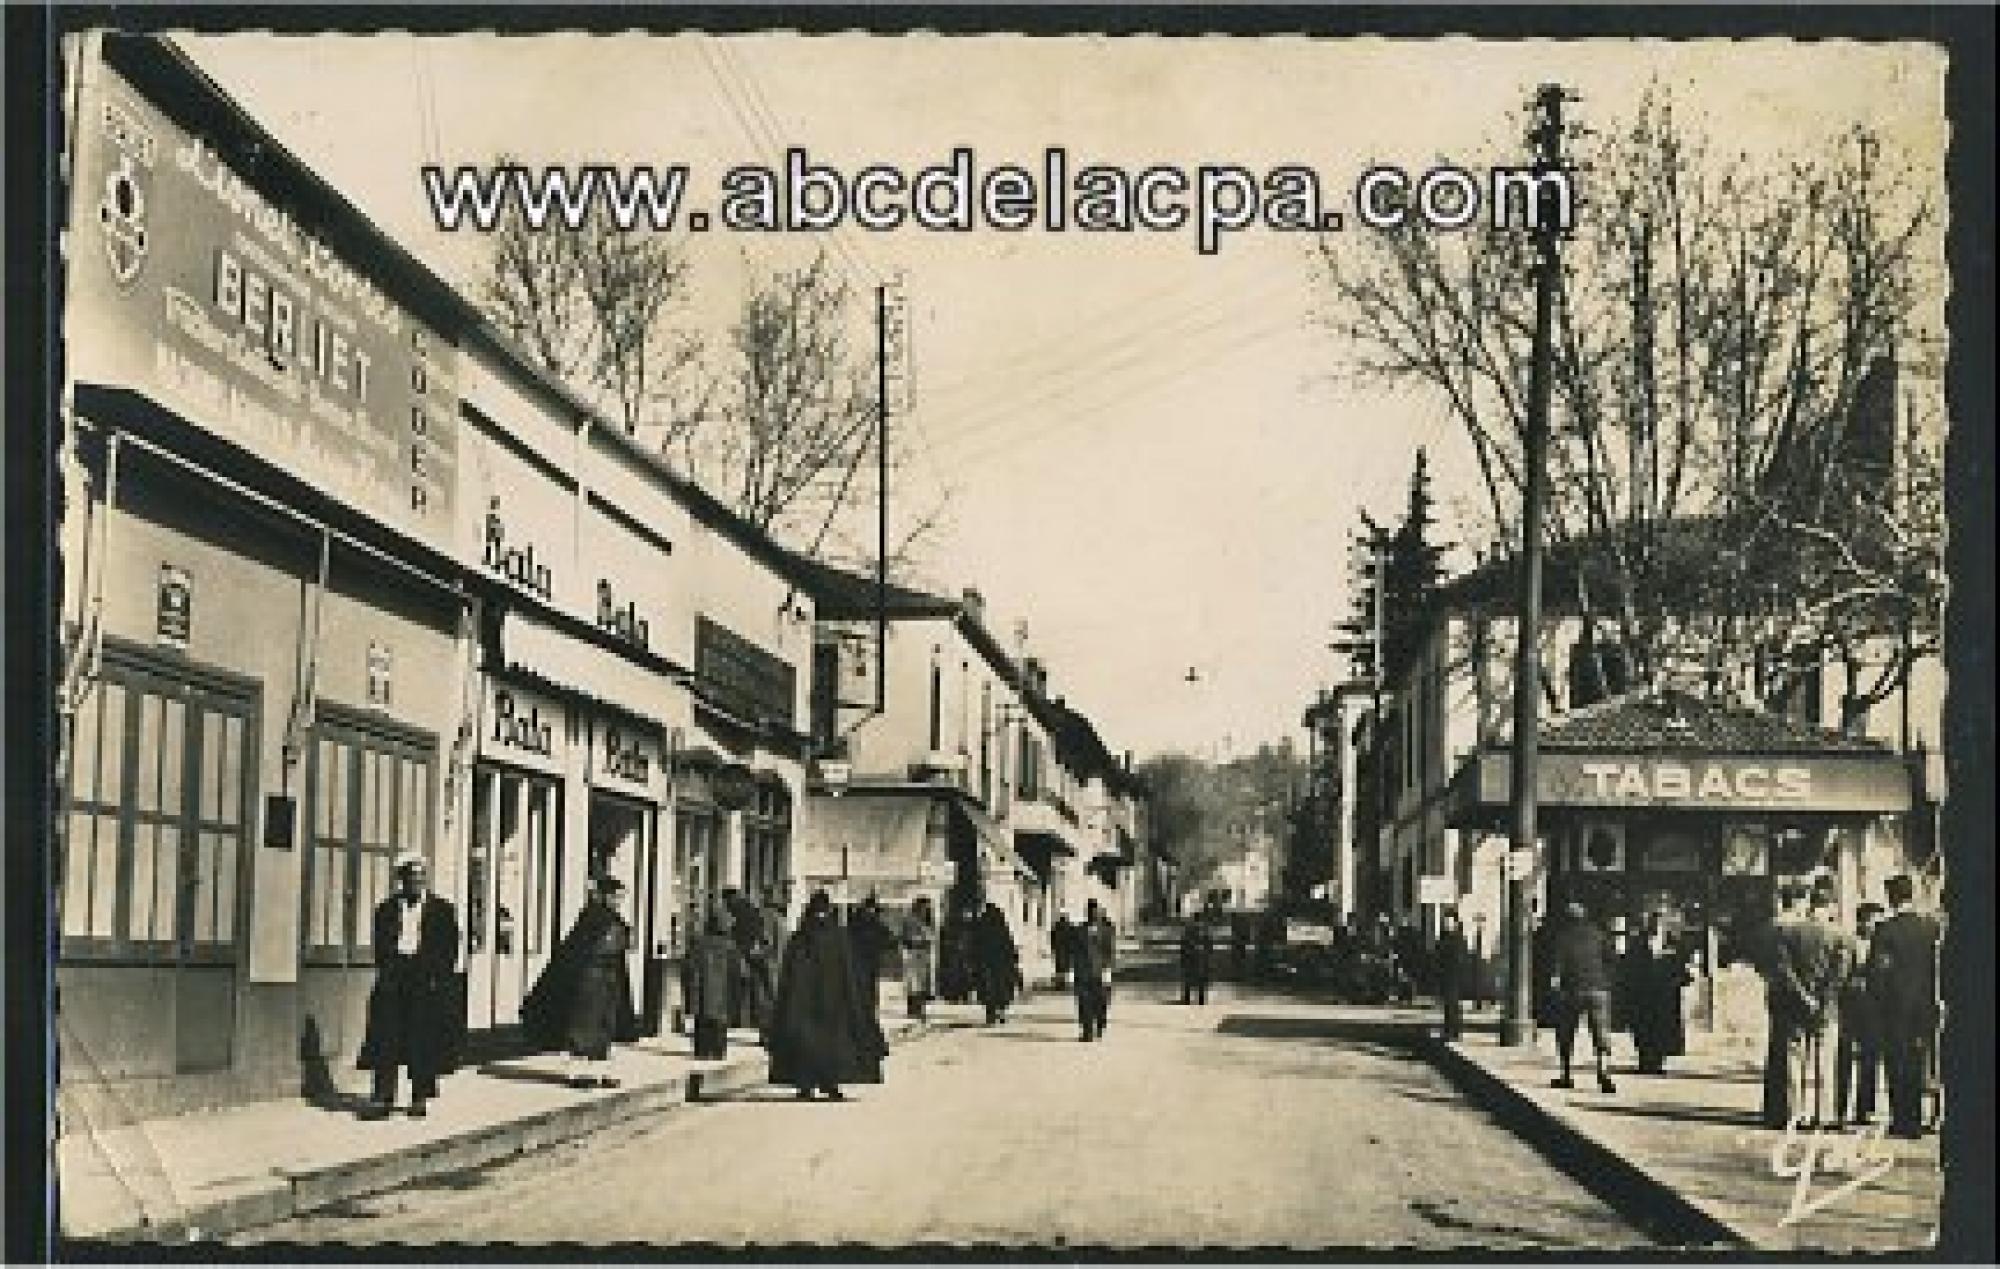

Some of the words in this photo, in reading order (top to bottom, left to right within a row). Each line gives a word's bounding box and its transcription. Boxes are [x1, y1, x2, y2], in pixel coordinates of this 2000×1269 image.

[213, 250, 371, 404] BERLIET
[482, 495, 551, 602] Bata
[492, 690, 551, 759] Bata
[1582, 763, 1811, 798] TABACS
